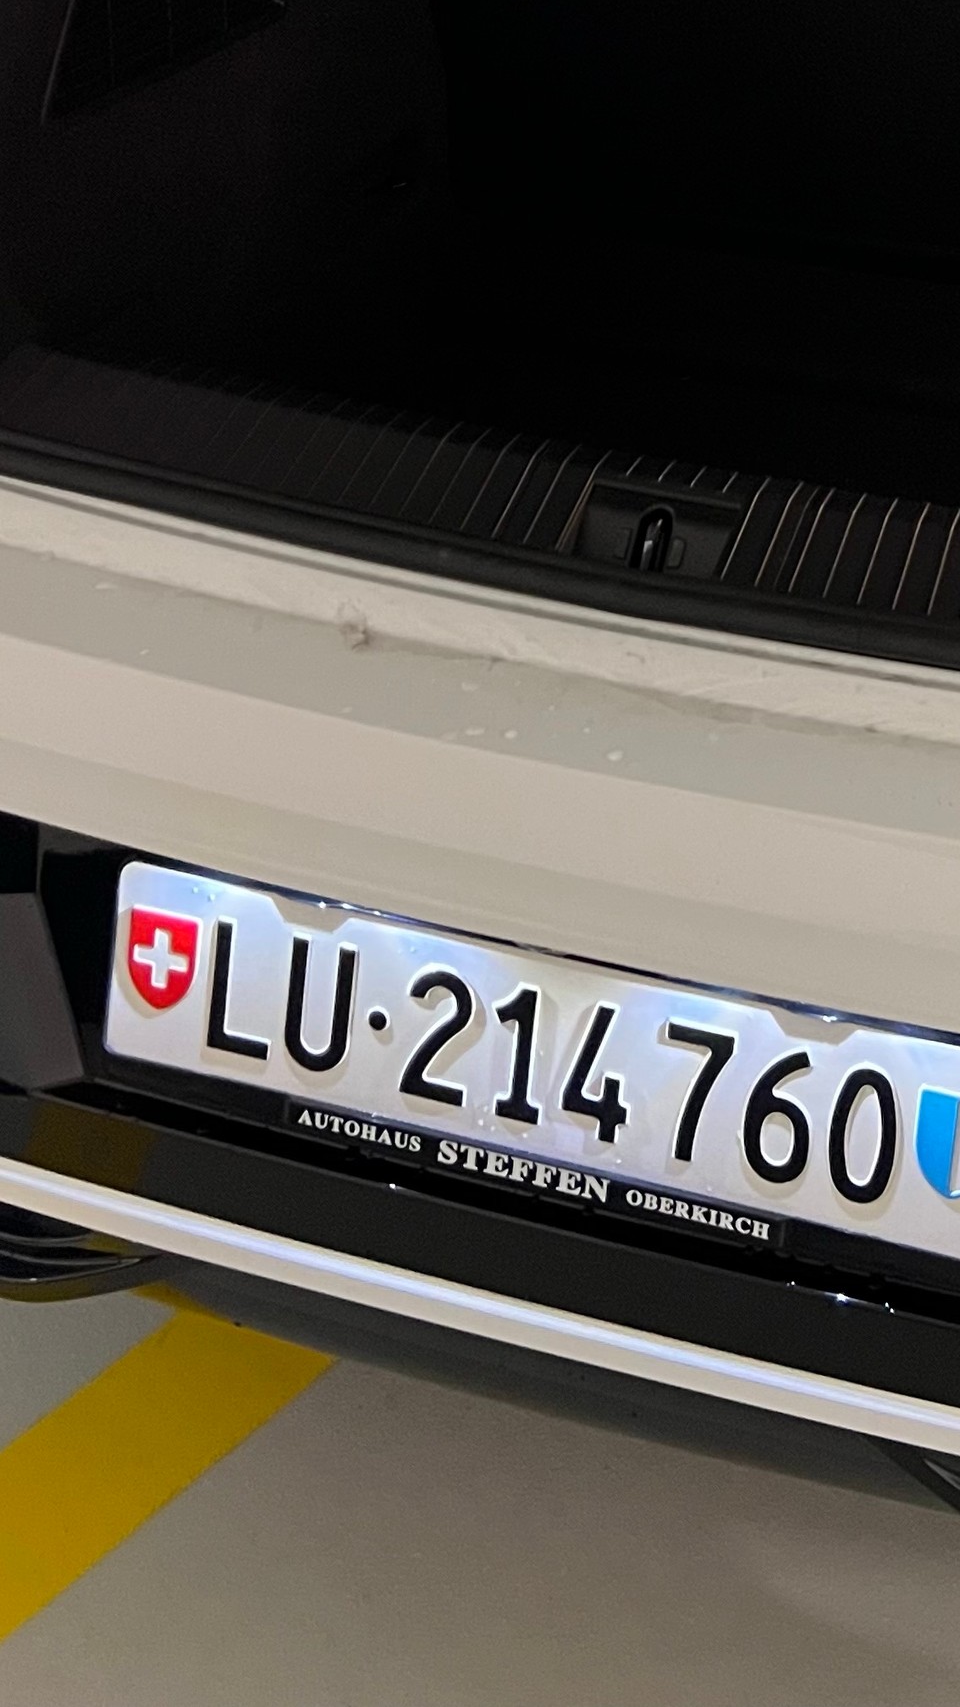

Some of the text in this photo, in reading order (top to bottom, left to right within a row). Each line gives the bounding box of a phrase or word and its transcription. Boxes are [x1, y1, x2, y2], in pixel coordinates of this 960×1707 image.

[298, 1109, 770, 1241] AUTOHAUS STEFFEN OBERKIRCH
